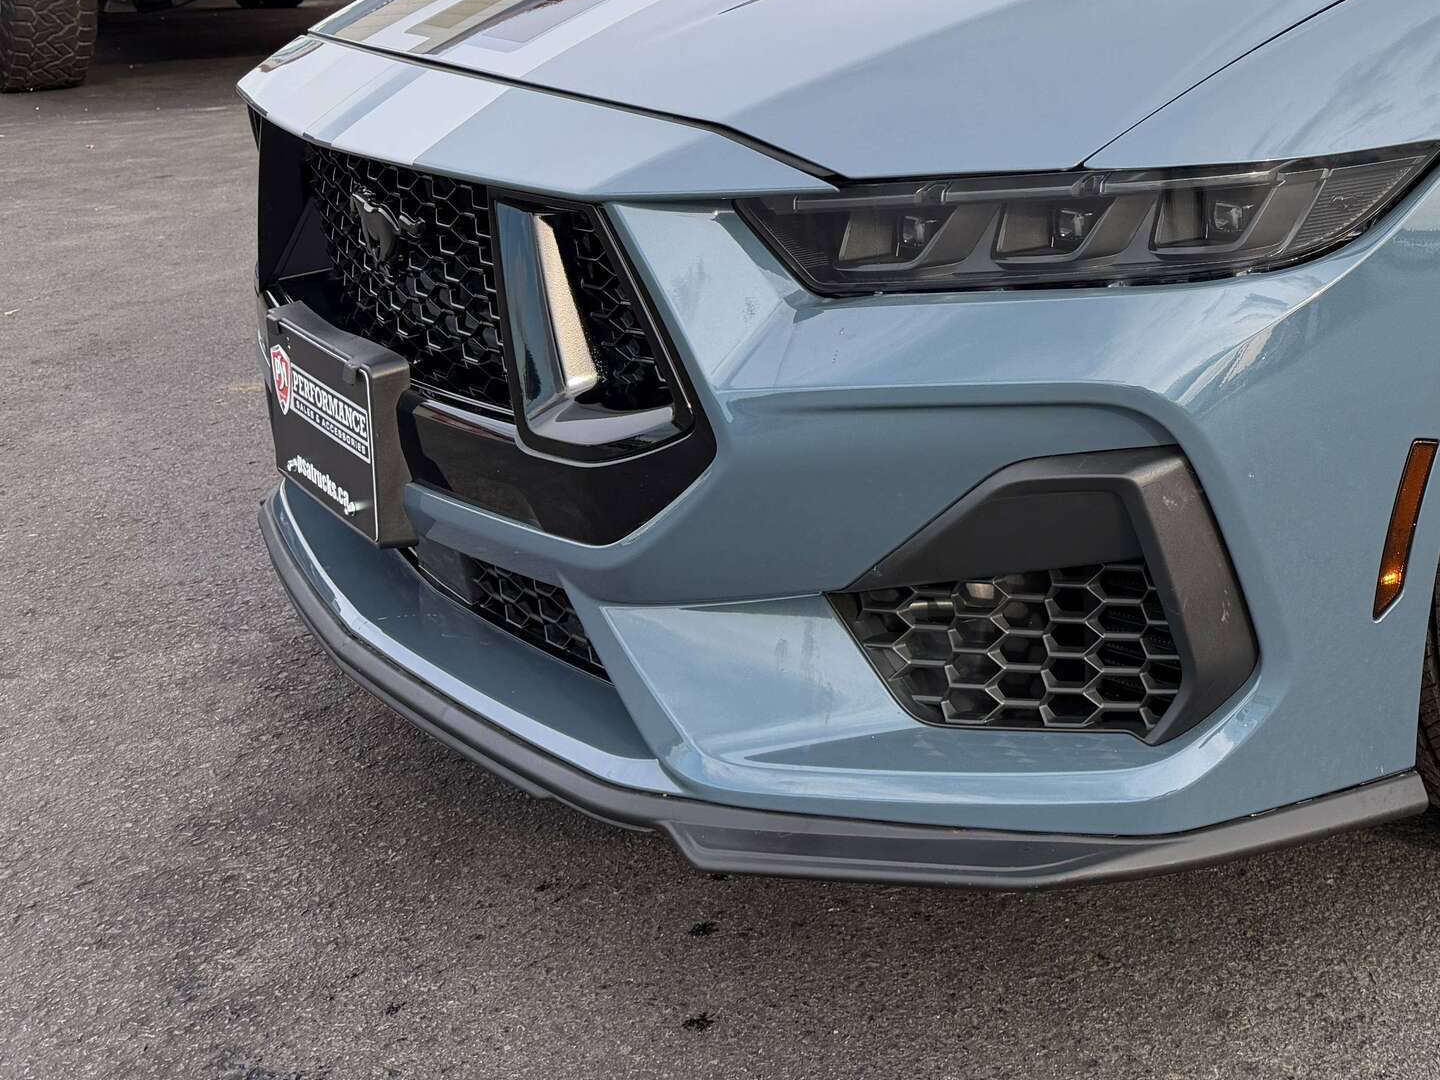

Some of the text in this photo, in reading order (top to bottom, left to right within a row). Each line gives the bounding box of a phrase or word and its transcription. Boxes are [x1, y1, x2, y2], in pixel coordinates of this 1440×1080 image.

[292, 370, 367, 438] PERFORMANCE
[296, 400, 315, 419] SALES
[321, 418, 366, 455] ACCESSORIES
[297, 455, 350, 507] psatrucks.ca
